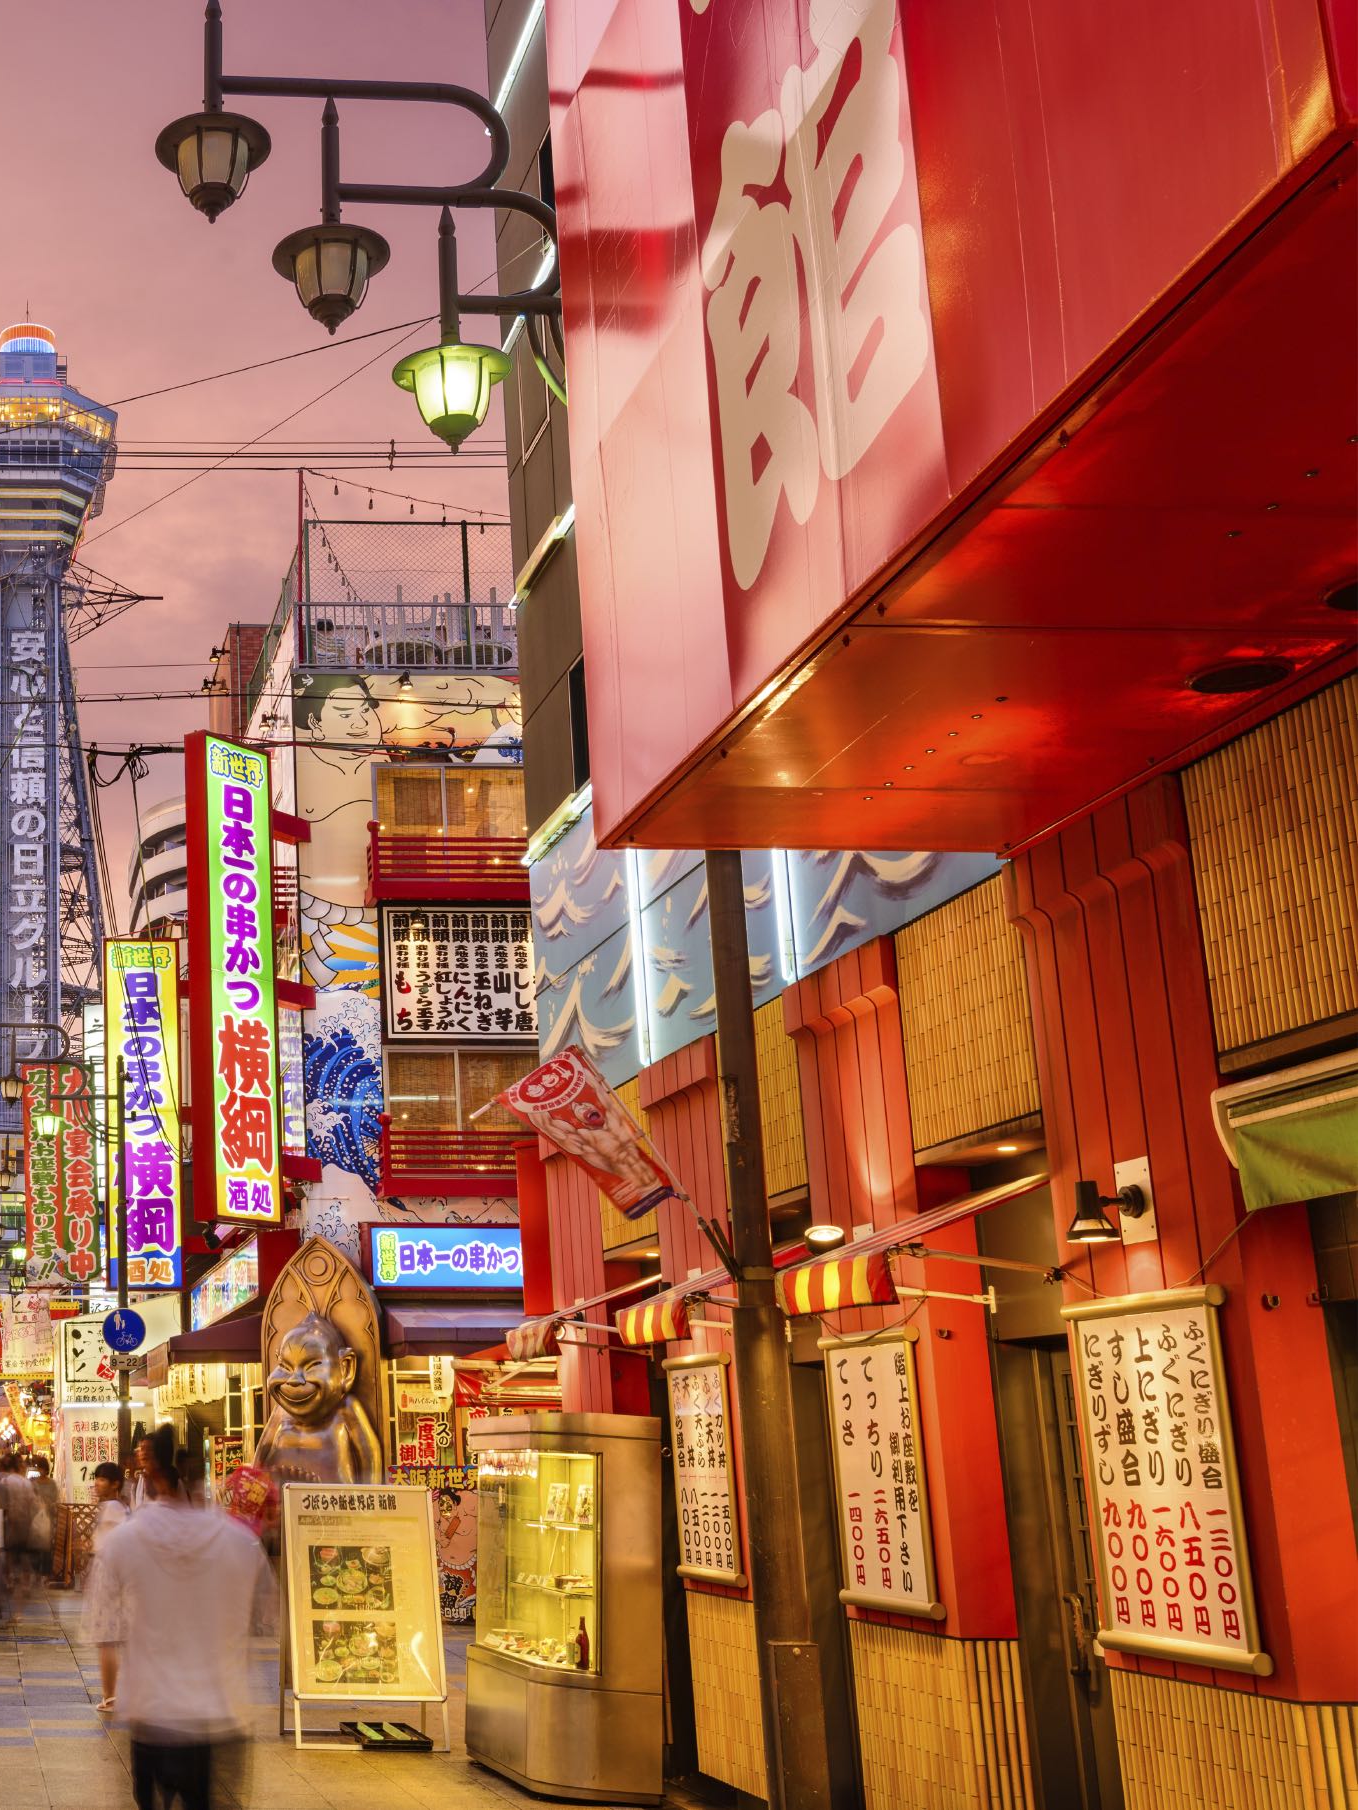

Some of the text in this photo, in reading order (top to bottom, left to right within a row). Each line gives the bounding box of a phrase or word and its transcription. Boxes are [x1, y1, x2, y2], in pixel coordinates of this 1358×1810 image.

[210, 746, 264, 787] 新世界
[9, 629, 49, 1060] 安心と信頼の日立グループ
[221, 785, 260, 1011] 日本一の串かつ
[112, 946, 171, 968] 新世界
[393, 914, 410, 943] 前頭
[432, 914, 450, 943] 前頭
[451, 914, 470, 943] 前頭
[471, 914, 489, 943] 前頭
[491, 914, 509, 943] 前頭
[510, 914, 529, 943] 前頭
[394, 971, 413, 1031] もち
[415, 971, 434, 1031] うずら玉子
[434, 971, 454, 1031] 紅しょうが
[453, 971, 473, 1031] にんにく
[474, 971, 494, 1031] 玉ねぎ
[493, 971, 513, 1031] 山芋
[514, 971, 534, 1031] しし唐
[122, 972, 164, 1136] 日本一の串かつ
[217, 1014, 274, 1175] 横綱
[228, 1179, 272, 1213] 酒処
[399, 1243, 519, 1272] 日本一の串かつ
[111, 1359, 138, 1367] 9-22
[837, 1358, 855, 1447] てっさ
[860, 1355, 883, 1478] てっちり
[1083, 1332, 1115, 1487] にぎりずし
[1107, 1328, 1142, 1488] すし盛合
[1133, 1327, 1165, 1486] 上にぎり
[1157, 1323, 1192, 1487] ふぐにぎり
[1183, 1320, 1224, 1490] ふぐにぎり盛合
